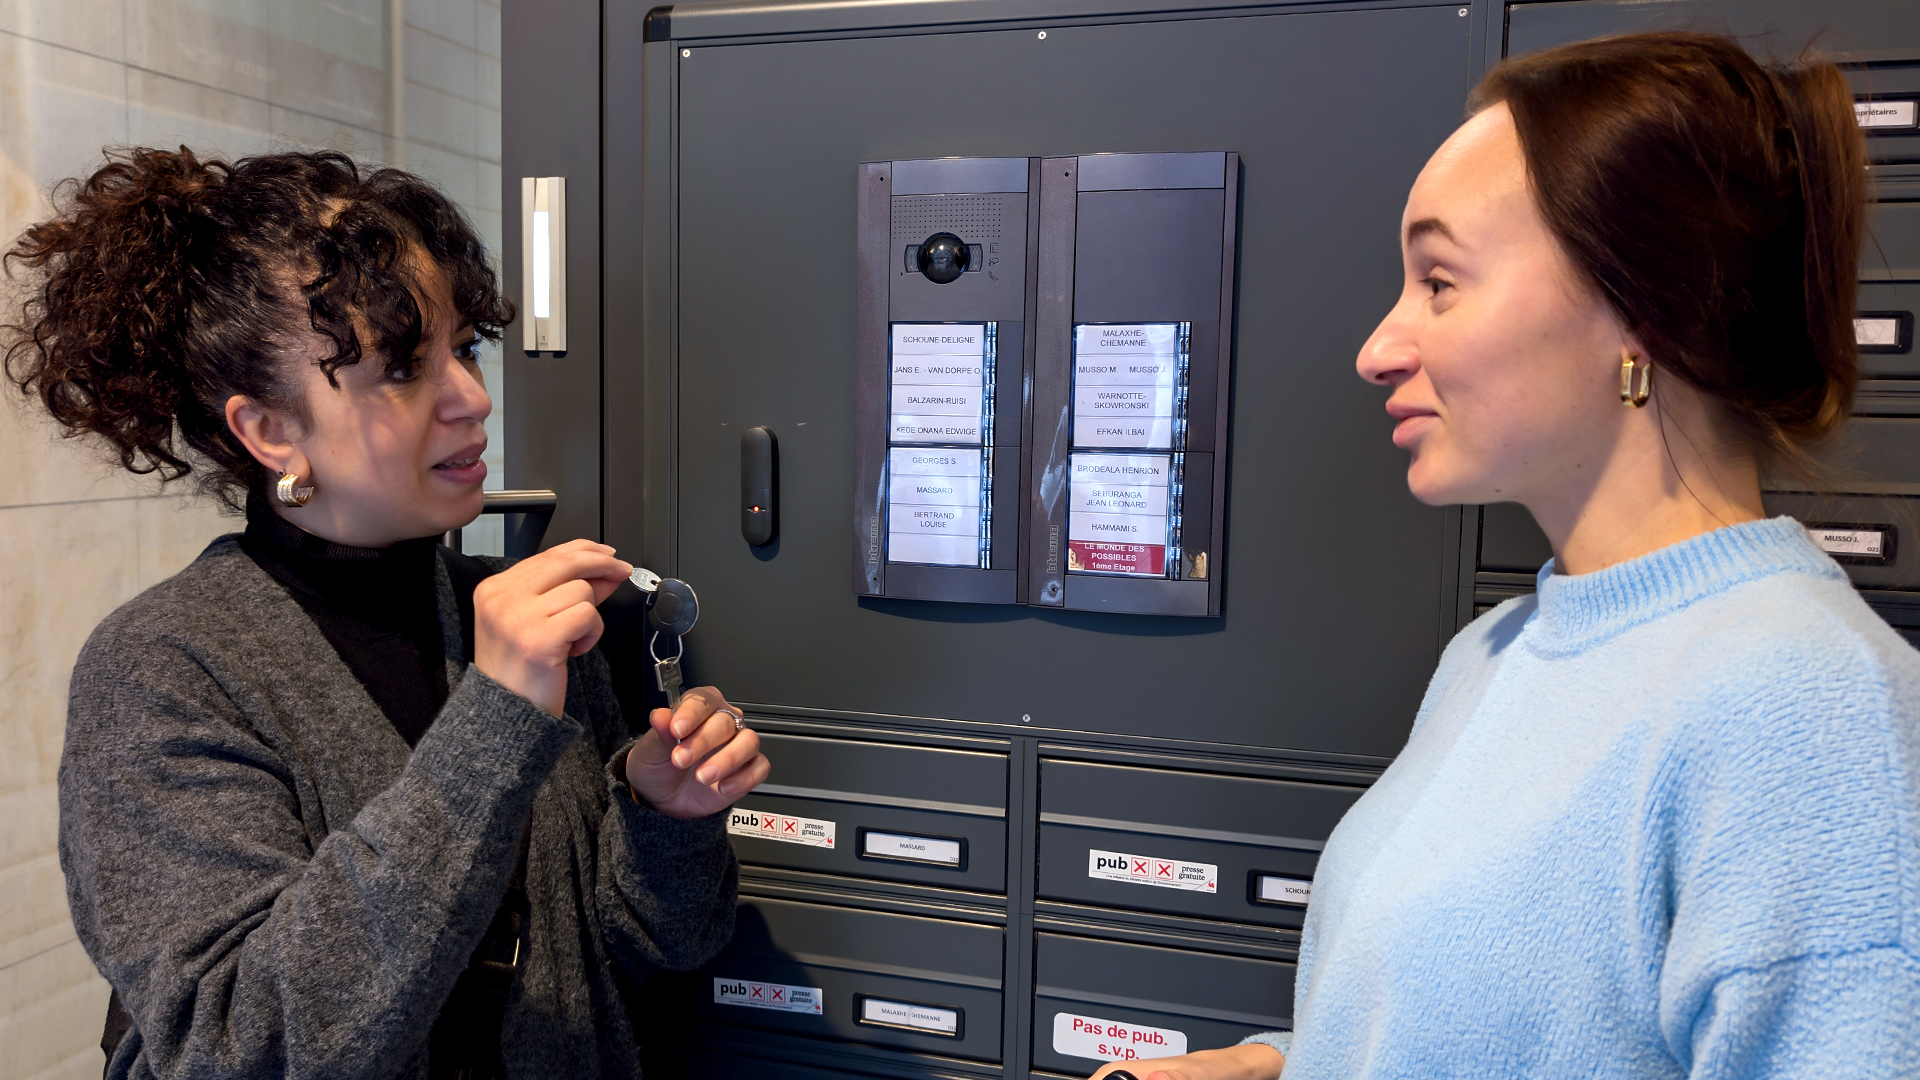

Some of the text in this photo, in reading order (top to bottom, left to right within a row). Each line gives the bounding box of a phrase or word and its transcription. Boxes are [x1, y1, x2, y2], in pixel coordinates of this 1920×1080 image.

[1102, 329, 1145, 337] MALAXHE-
[902, 336, 975, 344] SCHOUNE-DELIGNE
[1100, 339, 1147, 347] CHEMANNE
[894, 366, 913, 374] JANS
[1098, 392, 1146, 400] WARNOTTE-
[908, 397, 967, 405] BALZARIN-RUISI
[912, 457, 949, 465] GEORGES
[1077, 465, 1160, 475] BRODEALA HENRION
[916, 486, 953, 494] MASSARD
[1092, 490, 1142, 499] SEBURANGA
[1086, 499, 1148, 509] JEAN LEONARD
[920, 520, 947, 528] LOUISE
[1091, 524, 1130, 532] HAMMAMI
[1824, 535, 1853, 543] MUSSO
[1128, 545, 1145, 553] DES
[1092, 553, 1137, 562] POSSIBLES
[1114, 563, 1136, 572] Etage
[732, 814, 759, 827] pub
[802, 828, 825, 837] gratuite
[900, 843, 926, 851] MASSARD
[1097, 856, 1128, 870] pub
[1181, 866, 1204, 874] presse
[1178, 872, 1206, 881] gratuite
[720, 983, 747, 996] pub
[789, 996, 813, 1004] gratuite
[882, 1008, 906, 1017] MALAXHE
[911, 1013, 941, 1022] CHEMANNE
[1073, 1018, 1168, 1046] Pas de pub.
[1098, 1044, 1139, 1060] s.v.p.
